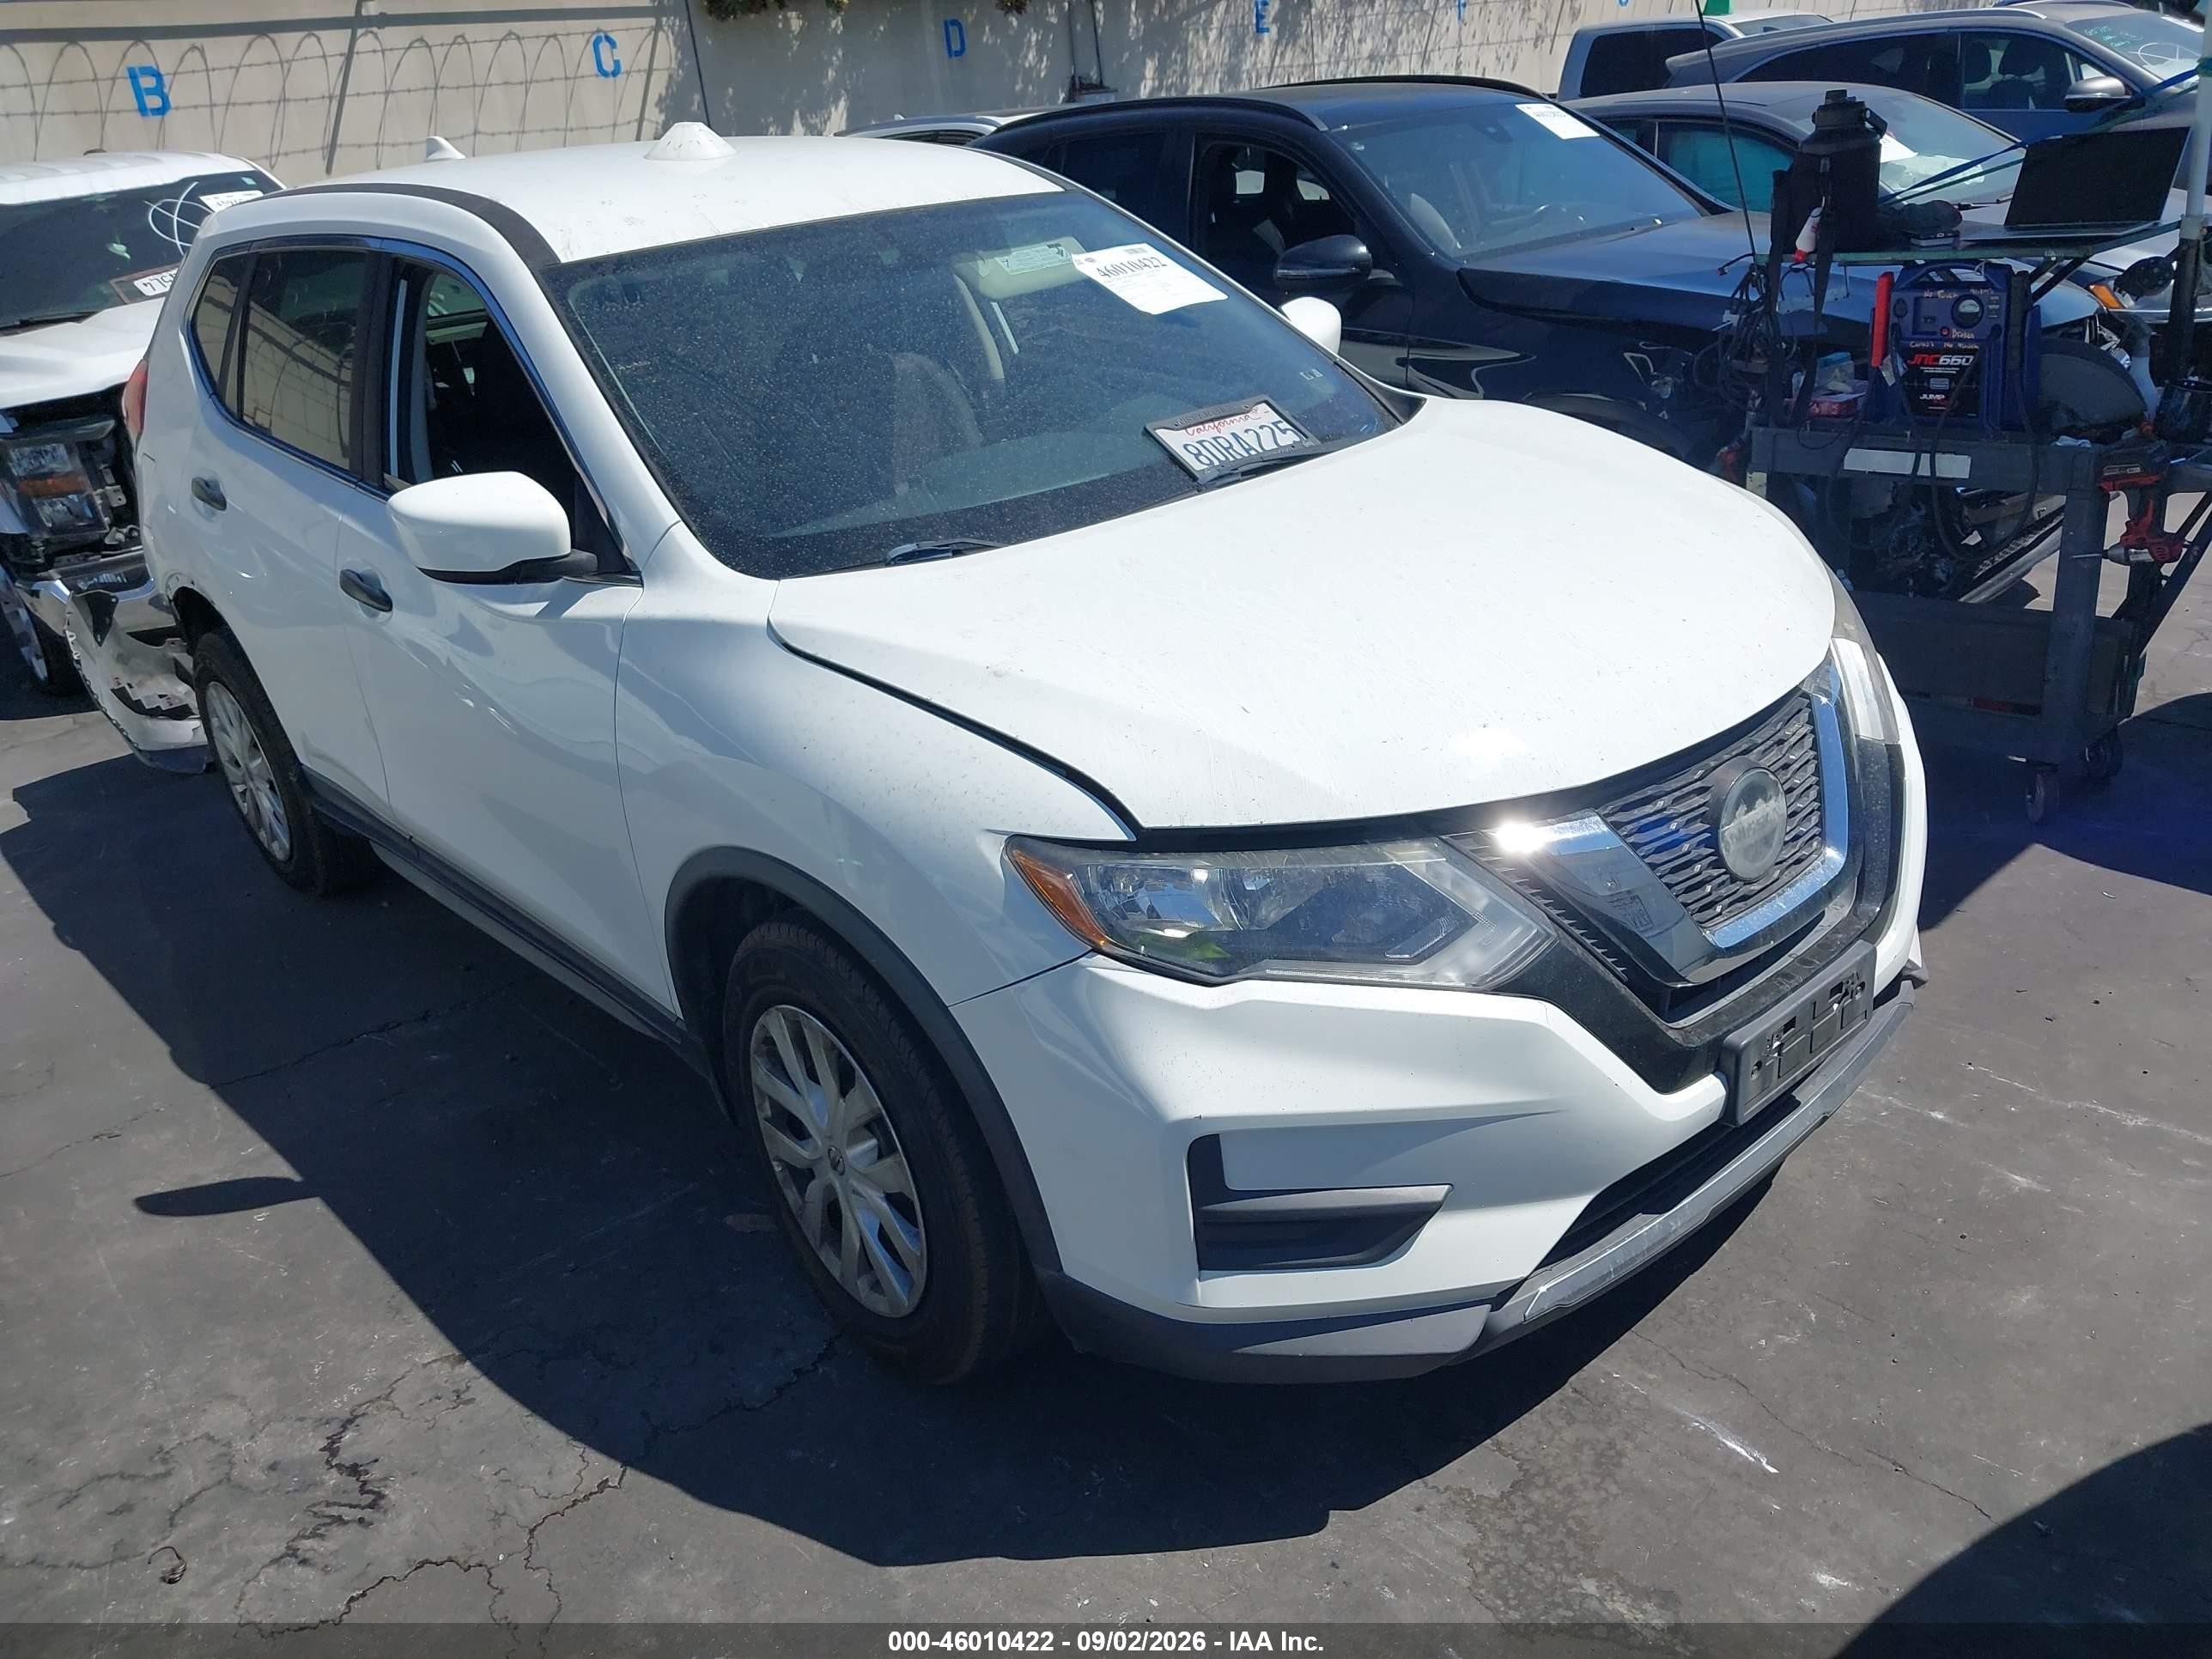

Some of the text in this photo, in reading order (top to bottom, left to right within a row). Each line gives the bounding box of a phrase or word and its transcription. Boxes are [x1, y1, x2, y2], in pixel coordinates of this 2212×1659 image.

[1255, 0, 1270, 33] E
[592, 34, 622, 78] C
[944, 19, 966, 58] D
[126, 65, 171, 117] B
[1097, 257, 1168, 278] 46010422
[1908, 354, 1974, 366] JNC660
[1185, 413, 1261, 436] California
[1183, 420, 1304, 468] 8DRA225
